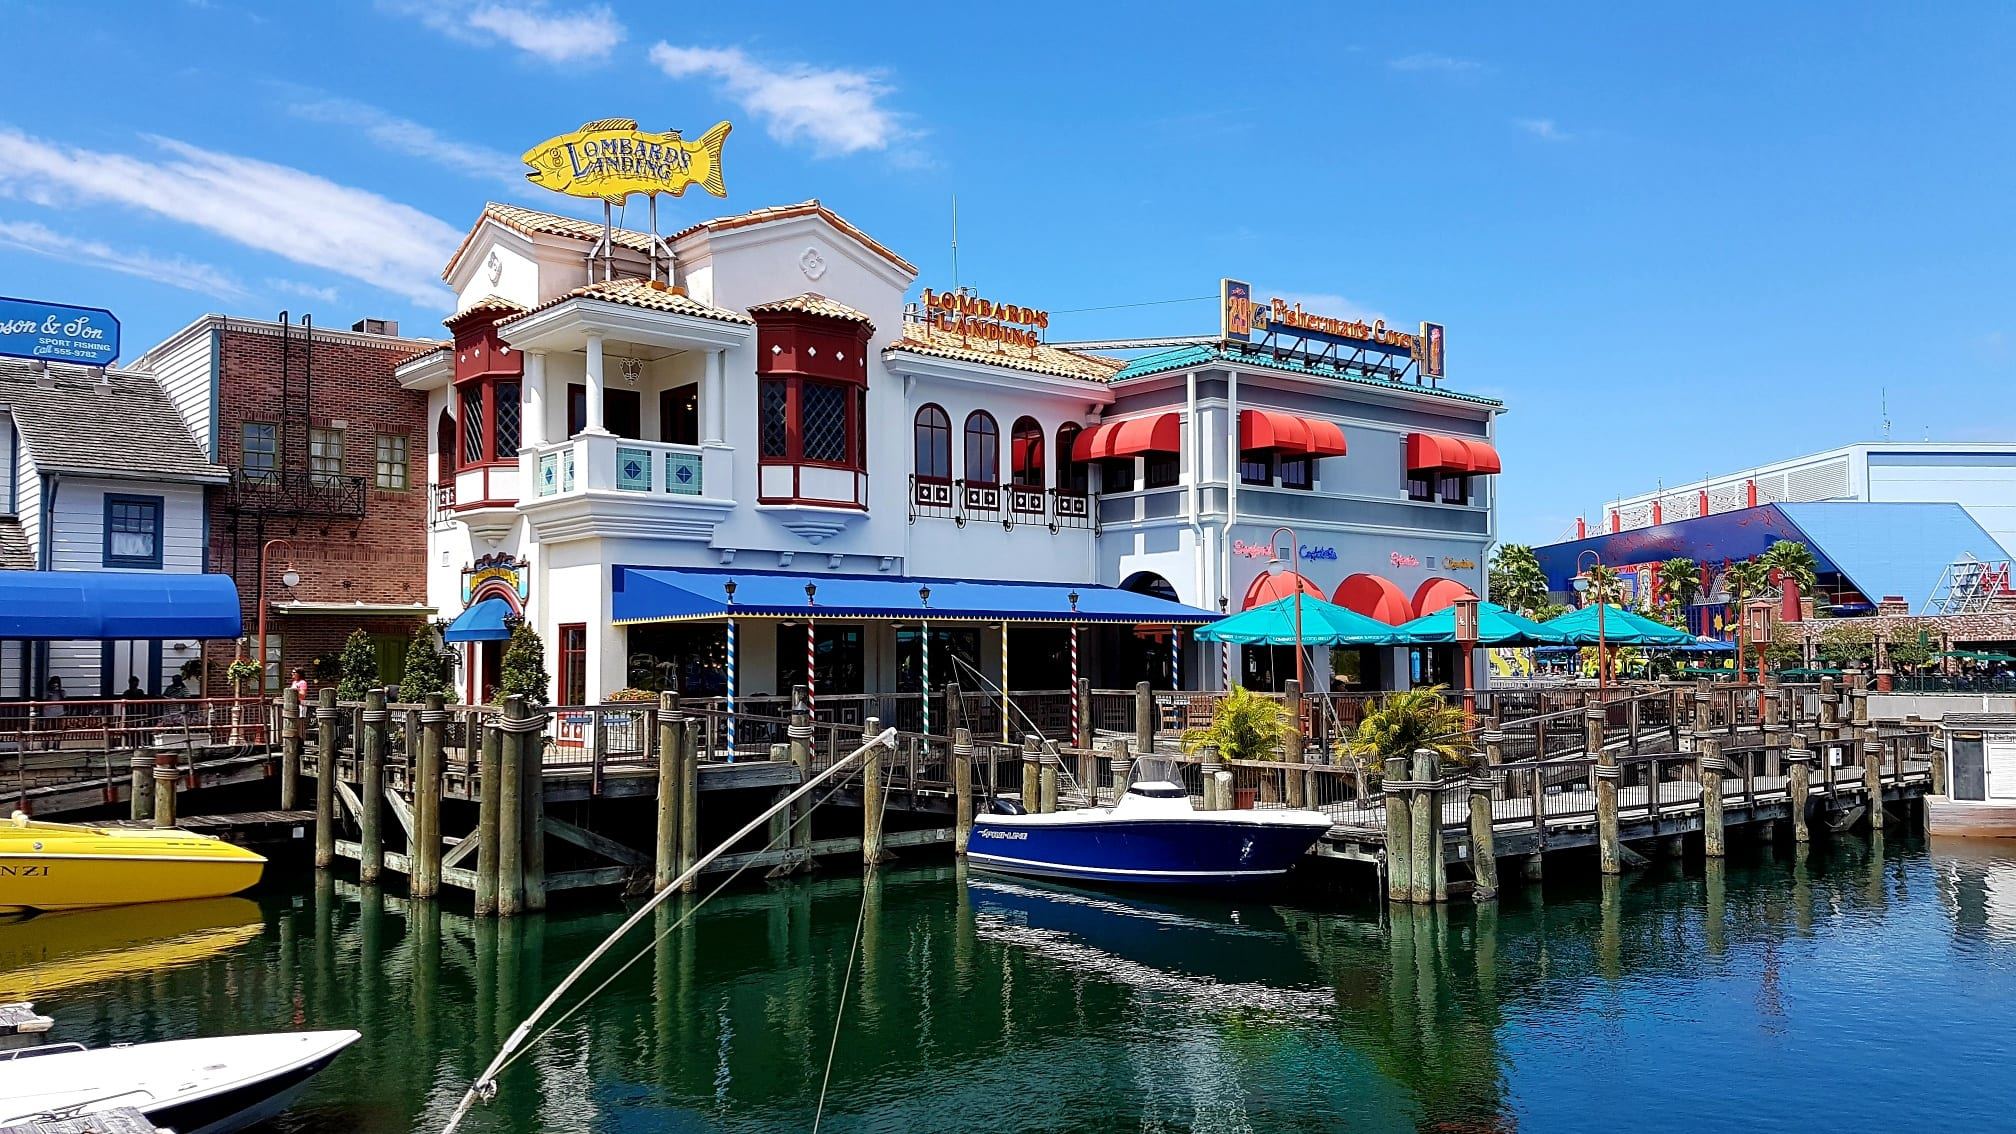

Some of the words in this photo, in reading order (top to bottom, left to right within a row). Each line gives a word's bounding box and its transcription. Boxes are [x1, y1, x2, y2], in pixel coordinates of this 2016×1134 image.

[923, 288, 1048, 328] LOMBARD'S
[41, 315, 60, 334] &
[64, 317, 103, 338] Son
[935, 312, 1037, 348] LANDING
[33, 345, 52, 355] Call
[39, 338, 71, 347] SPORT
[74, 341, 111, 351] FISHING
[0, 866, 50, 876] NZI
